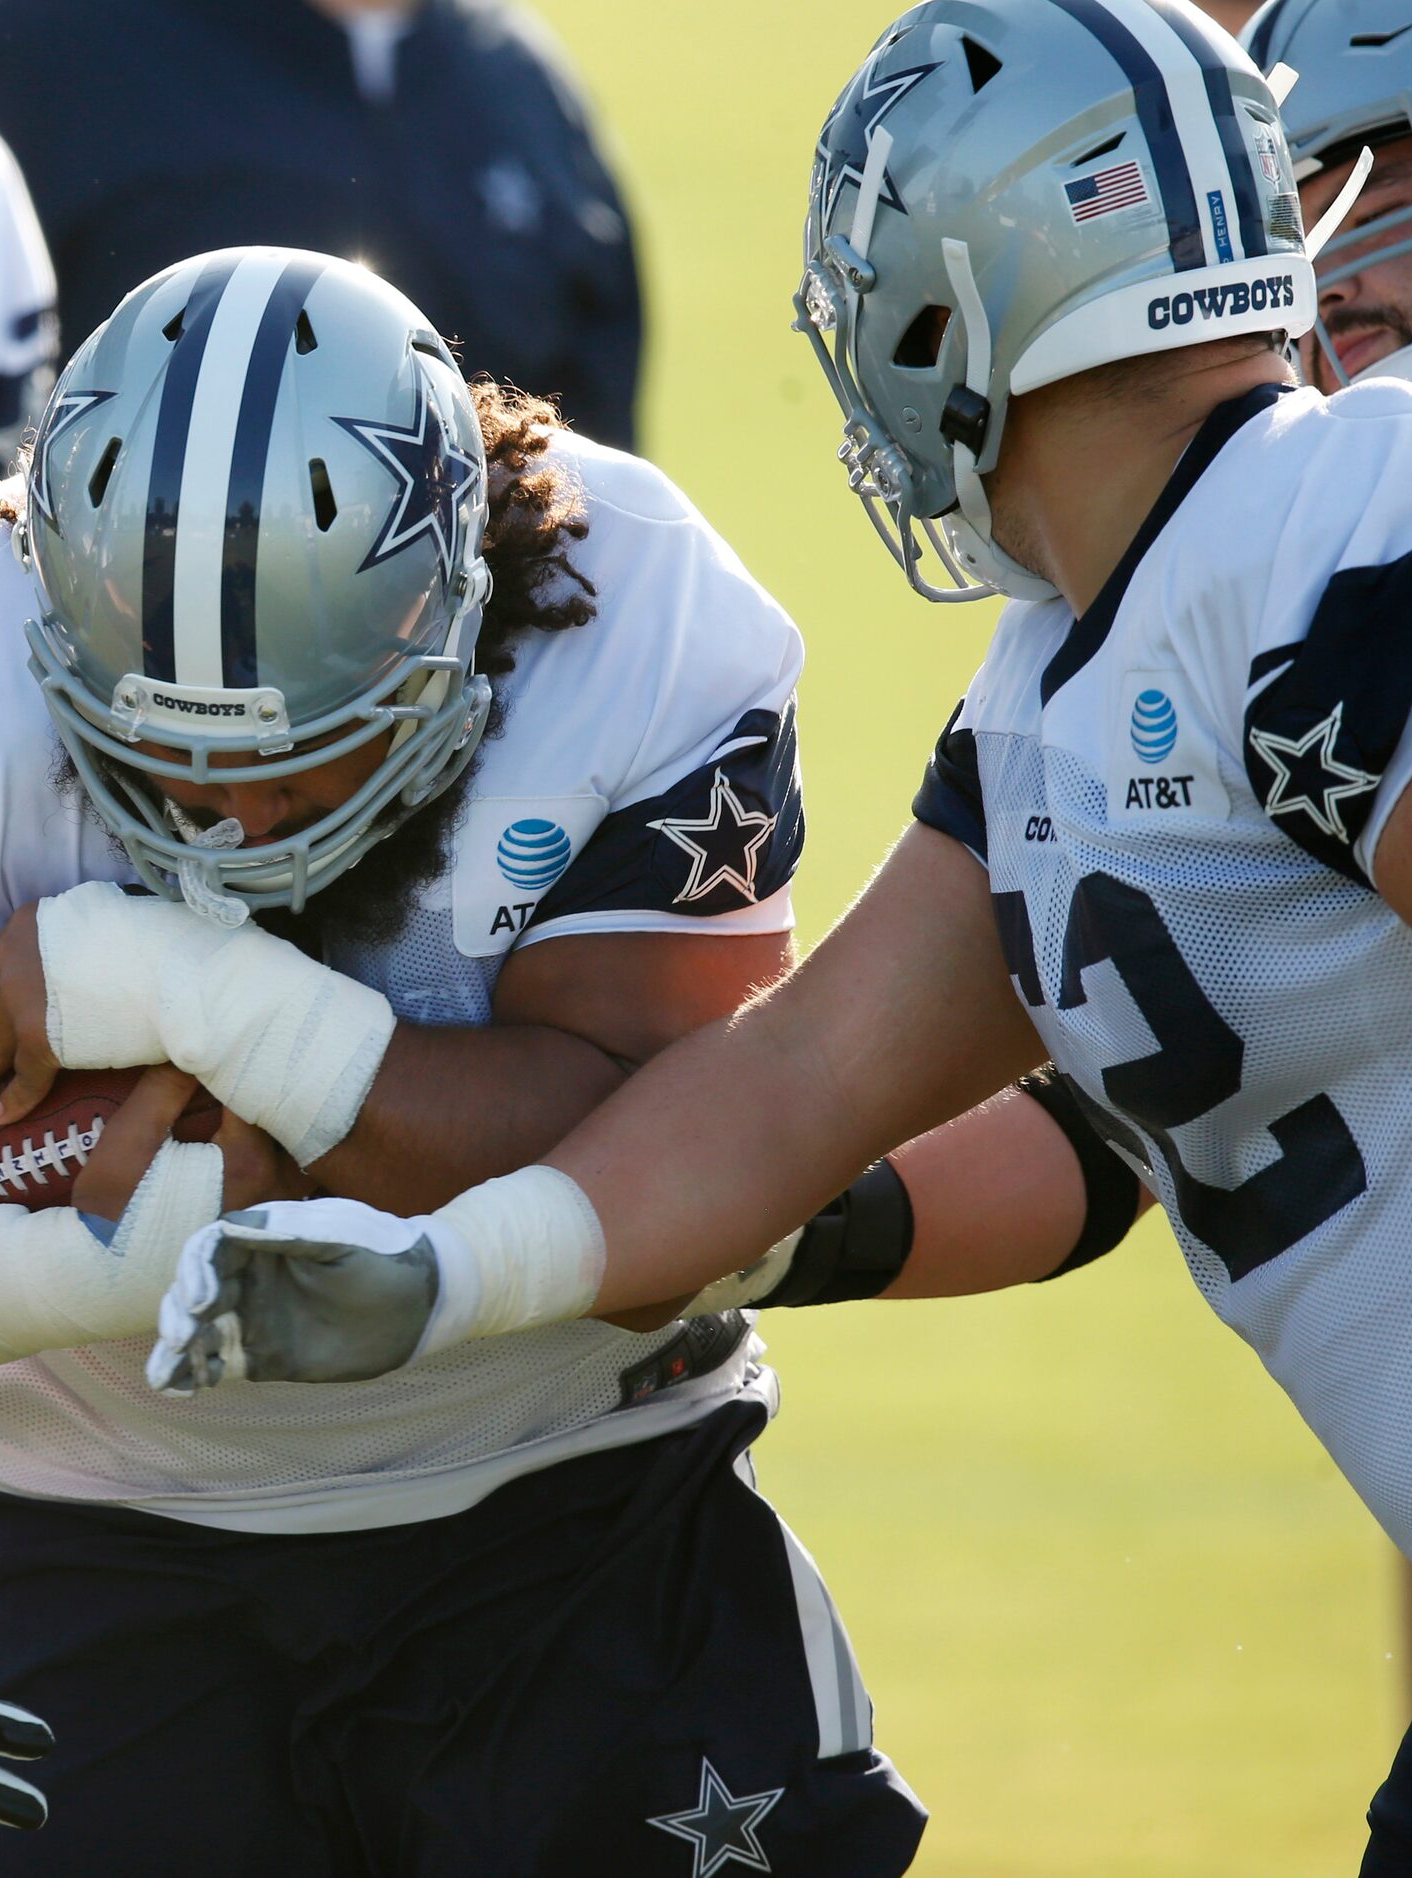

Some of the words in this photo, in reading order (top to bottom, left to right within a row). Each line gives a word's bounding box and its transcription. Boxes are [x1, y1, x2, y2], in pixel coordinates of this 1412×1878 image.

[1213, 196, 1228, 248] HENRY
[1148, 275, 1294, 330] COWBOYS
[153, 693, 246, 716] COWBOYS
[1125, 775, 1195, 809] AT&T
[490, 902, 536, 935] AT
